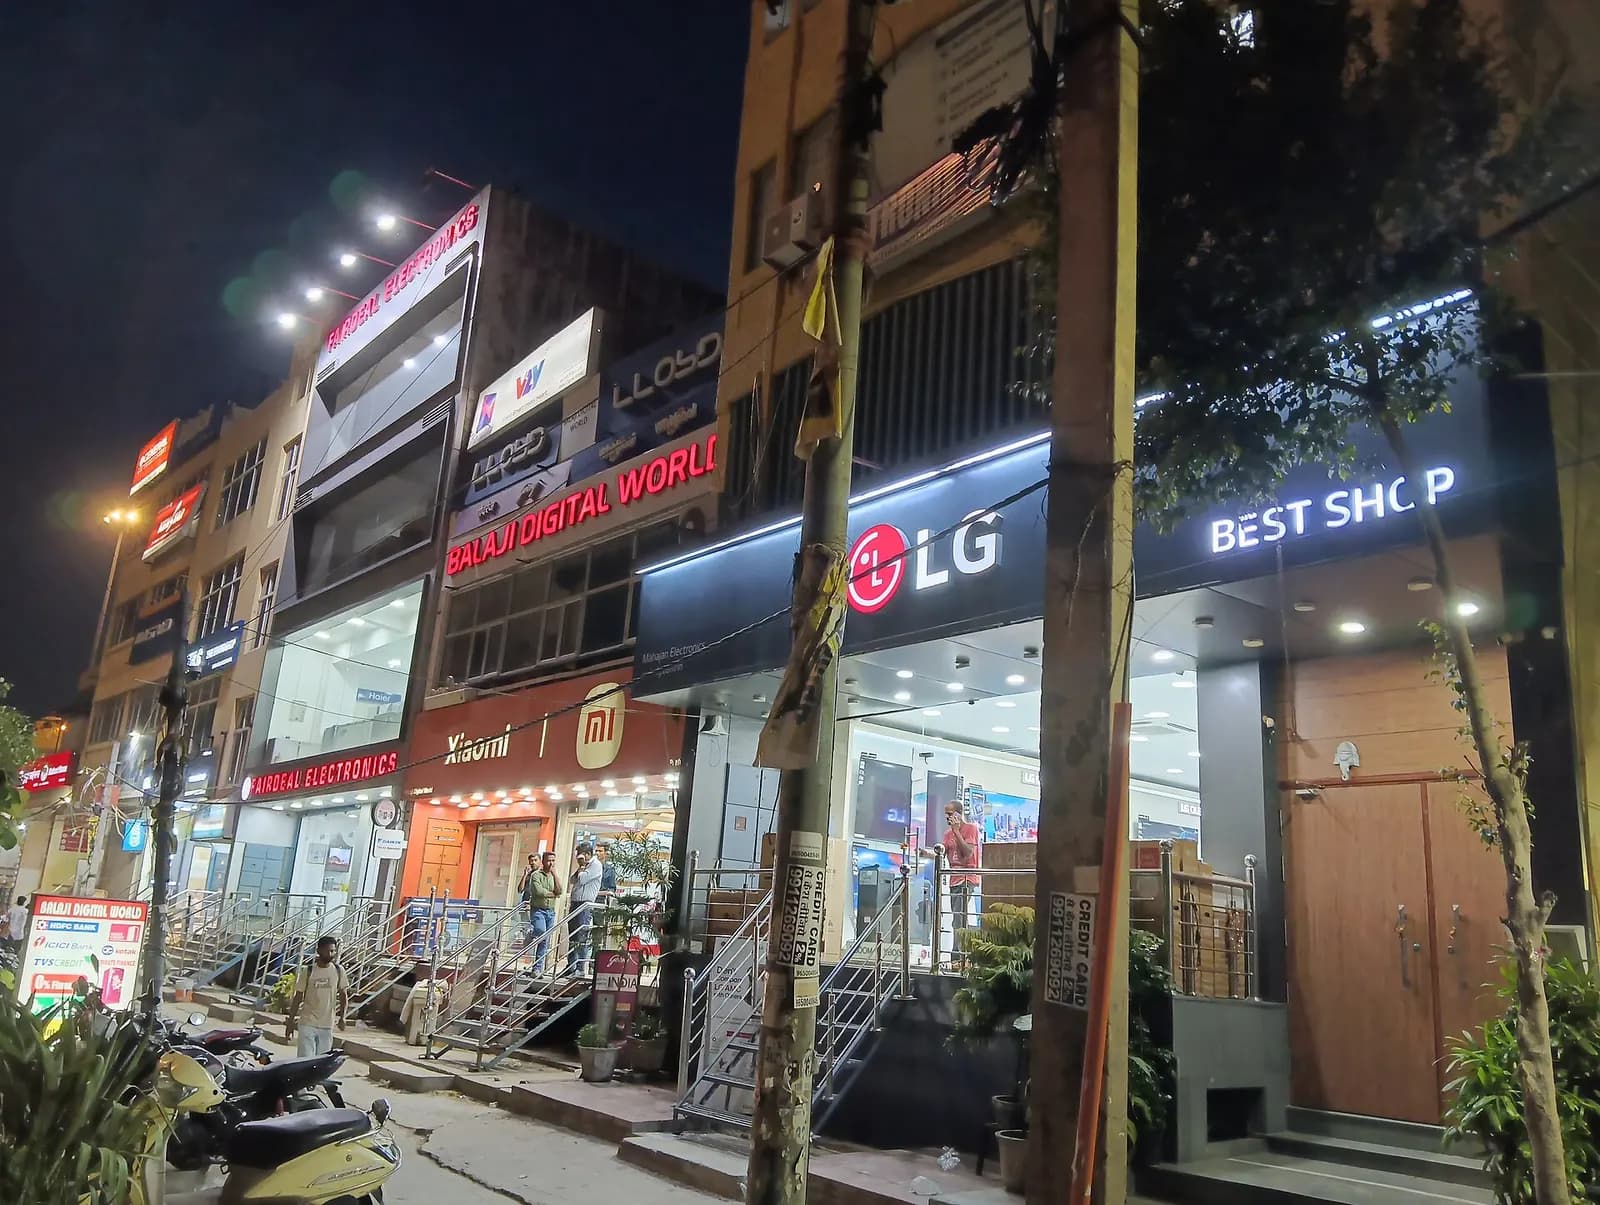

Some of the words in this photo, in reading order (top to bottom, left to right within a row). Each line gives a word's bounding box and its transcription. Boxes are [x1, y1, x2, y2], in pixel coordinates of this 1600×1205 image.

[327, 293, 380, 353] FAIRDEAL
[384, 203, 479, 303] ELECTRONICS
[447, 510, 518, 577] BALAJI
[520, 482, 610, 545] DIGITAL
[1211, 498, 1313, 555] BEST
[913, 508, 1004, 592] LG
[669, 641, 706, 658] Electronics
[368, 691, 392, 702] Haier
[444, 723, 512, 766] Xiaomi
[250, 773, 301, 799] FAIRDEAL
[304, 752, 399, 788] ELECTRONICS
[40, 901, 71, 914] BALAJI
[73, 903, 107, 917] DIGITAL
[110, 906, 142, 919] WORLD
[779, 868, 803, 962] 9911269092
[812, 870, 824, 923] CREDIT
[806, 927, 818, 967] CARD
[1048, 896, 1064, 999] 9911269092
[1077, 899, 1091, 958] CREDIT
[54, 959, 84, 967] CREDIT
[794, 942, 806, 964] 2%
[608, 976, 637, 989] INDIA
[1074, 962, 1088, 1007] CARD
